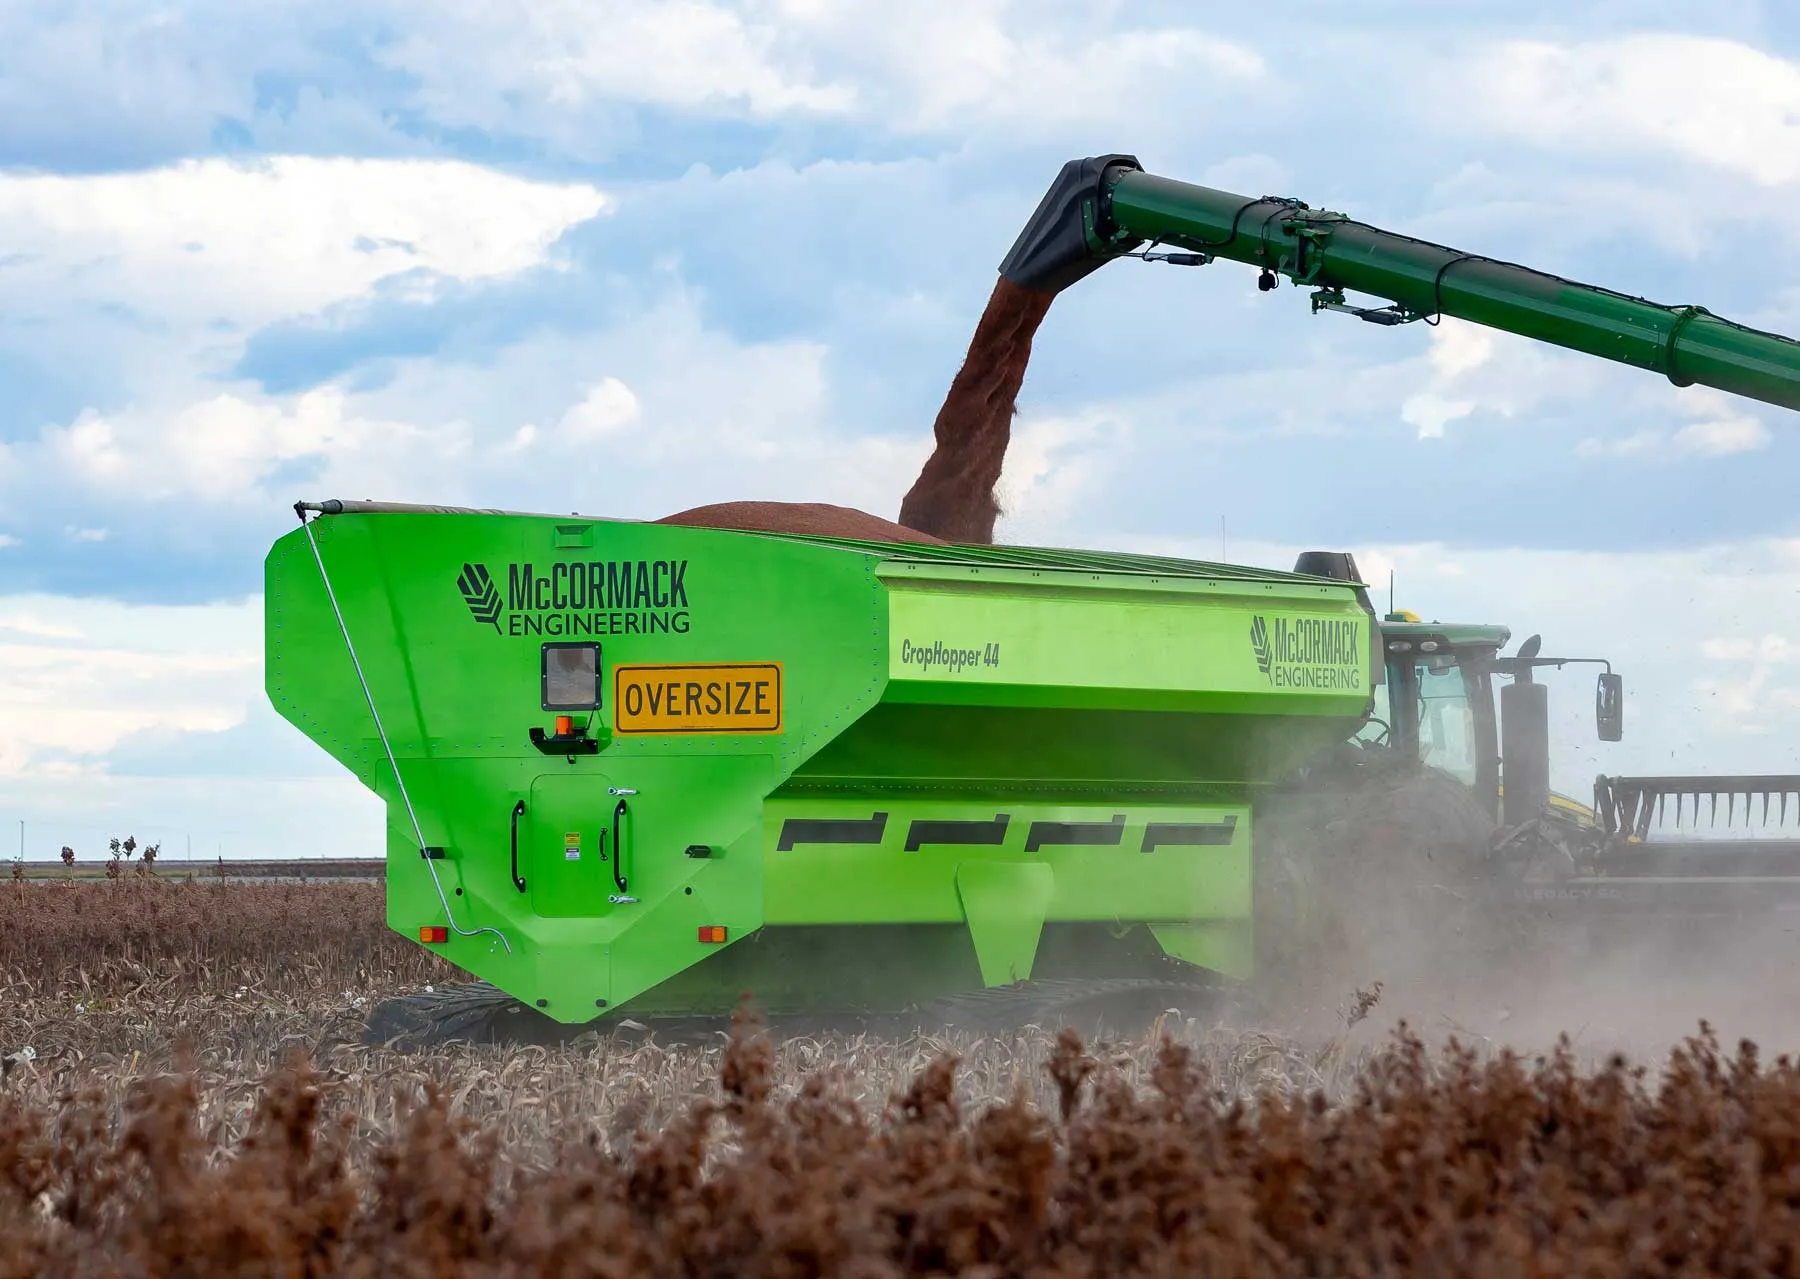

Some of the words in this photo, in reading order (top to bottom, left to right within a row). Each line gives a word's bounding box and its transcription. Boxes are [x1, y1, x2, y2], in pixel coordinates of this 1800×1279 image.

[508, 560, 688, 611] McCORMACK
[509, 612, 690, 636] ENGINEERING
[902, 639, 981, 672] CropHopper
[982, 643, 999, 667] 44
[1275, 618, 1358, 666] McCORMACK
[1276, 665, 1359, 688] ENGINEERING
[624, 681, 771, 716] OVERSIZE
